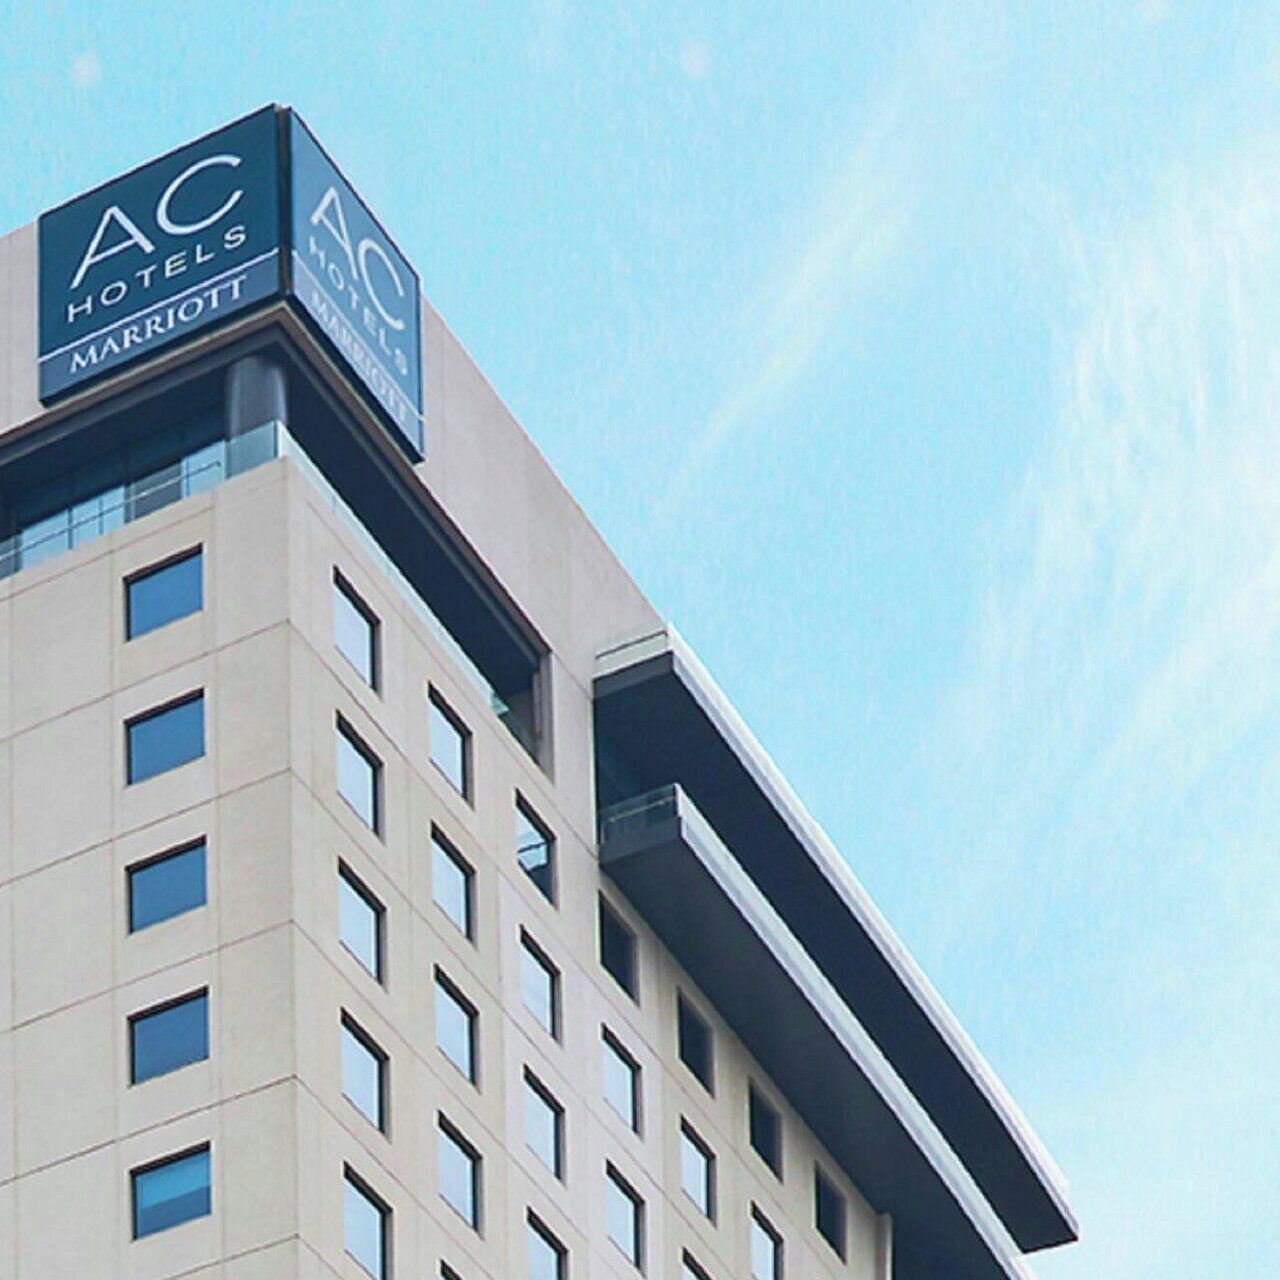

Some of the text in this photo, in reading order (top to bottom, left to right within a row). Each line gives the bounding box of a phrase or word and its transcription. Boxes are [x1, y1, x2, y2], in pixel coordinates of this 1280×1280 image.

[68, 225, 246, 323] HOTELS
[71, 154, 243, 290] AC
[310, 186, 405, 331] AC
[70, 274, 247, 374] MARRIOTT
